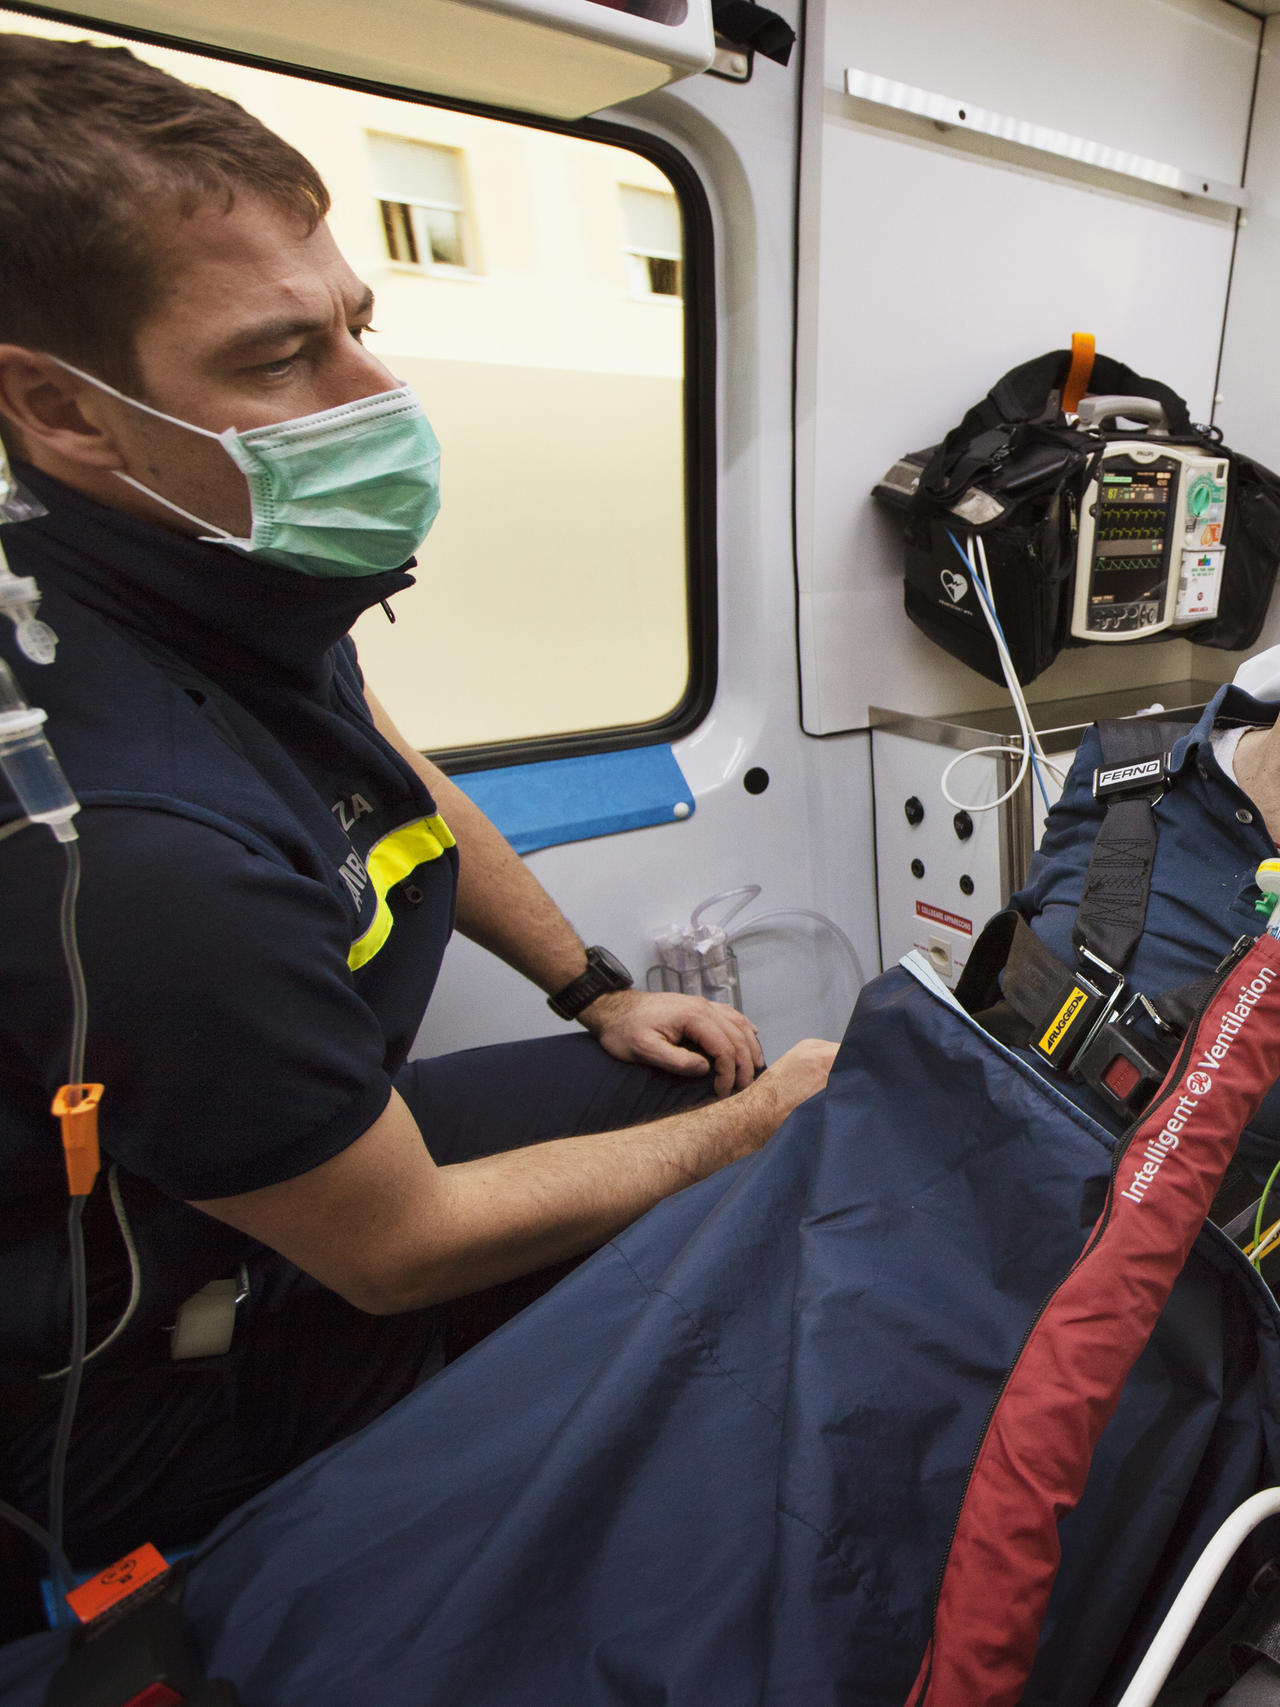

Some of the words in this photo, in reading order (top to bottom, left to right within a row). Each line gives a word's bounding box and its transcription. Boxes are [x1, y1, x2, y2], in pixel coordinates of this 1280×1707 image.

[1102, 763, 1158, 783] FERNO
[1048, 998, 1081, 1045] RUGGED
[1121, 1095, 1199, 1203] Intelligent
[1198, 967, 1277, 1070] Ventilation
